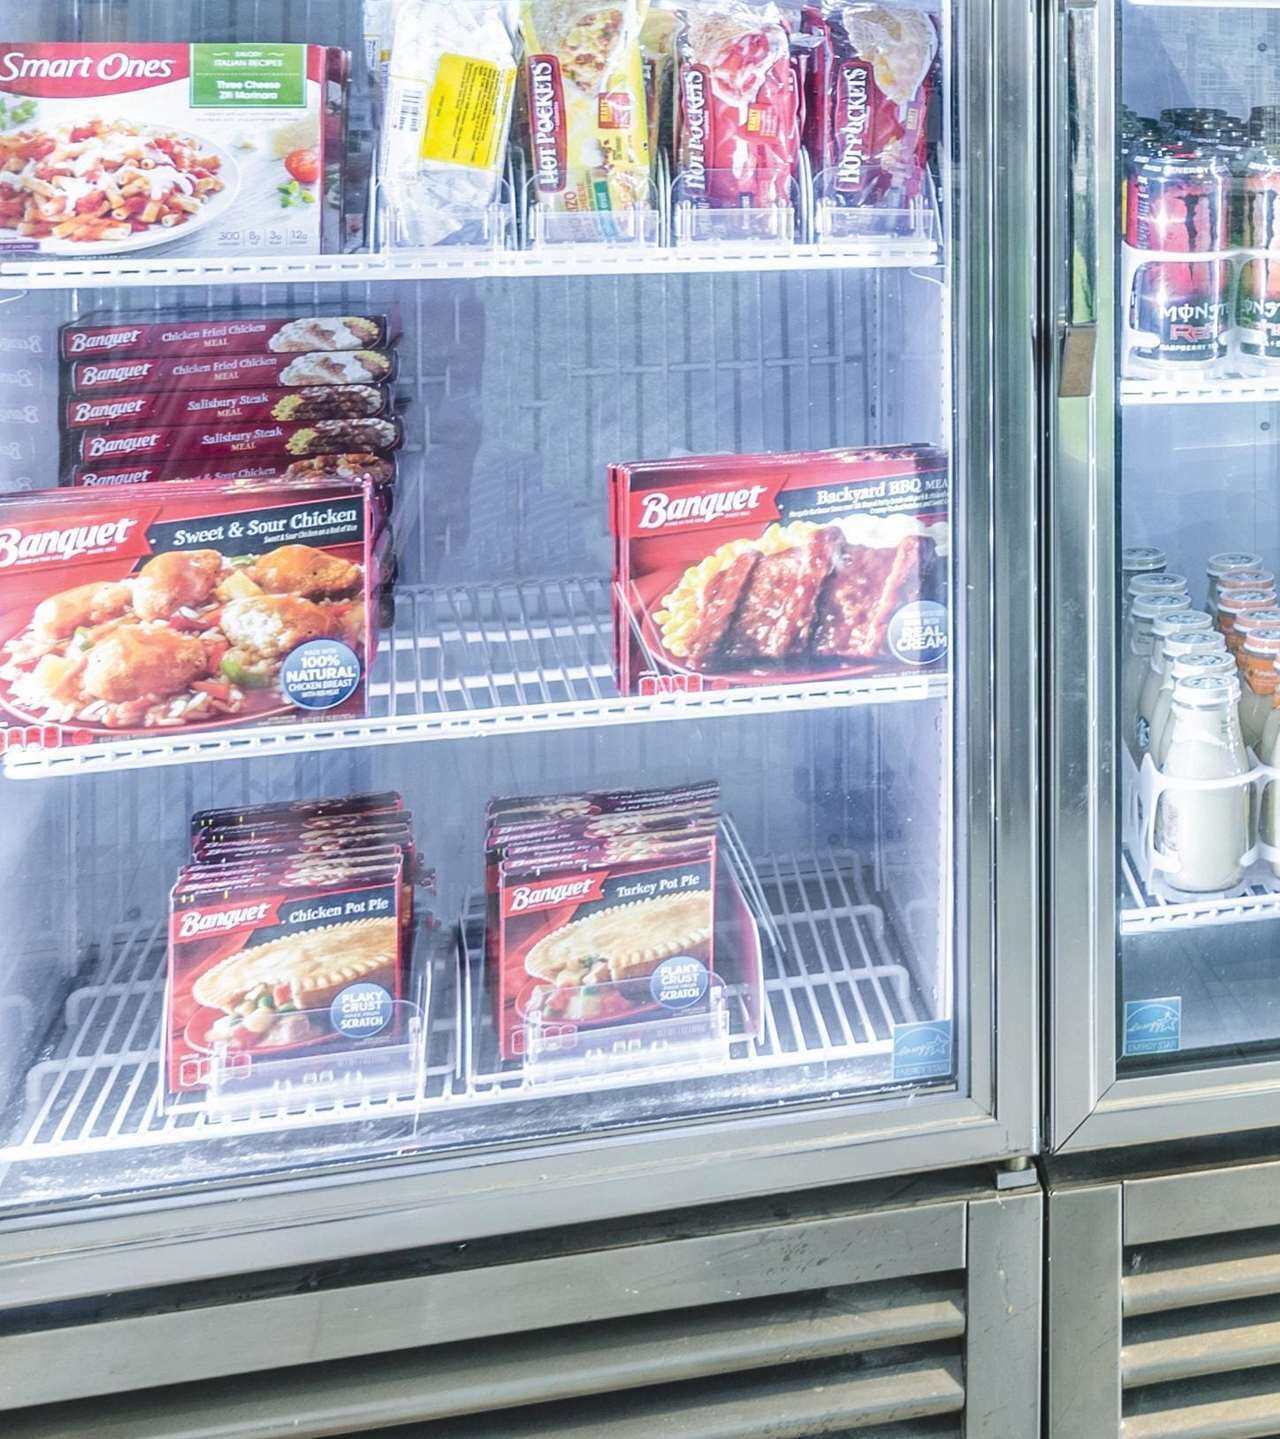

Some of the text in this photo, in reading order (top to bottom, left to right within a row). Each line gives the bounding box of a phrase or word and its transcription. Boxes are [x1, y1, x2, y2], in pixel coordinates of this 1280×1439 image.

[0, 52, 176, 81] Smart Ones
[216, 80, 281, 90] Three Cheese
[528, 61, 556, 149] POCKETS
[71, 328, 142, 353] Banquet
[161, 323, 266, 342] Chicken Fried Chicken
[203, 338, 228, 347] MEAL
[81, 362, 153, 386] Banquet
[173, 356, 277, 375] Chicken Fried Chicken
[214, 371, 240, 380] MEAL
[75, 399, 147, 423] Banquet
[187, 393, 269, 412] Salisbury Steak
[217, 408, 242, 417] MEAL
[89, 431, 161, 456] Banquet
[201, 427, 282, 445] Salisbury Steak
[231, 441, 256, 451] MEAL
[816, 483, 885, 507] Backyard
[888, 478, 921, 497] BBQ
[638, 484, 768, 529] Banquet
[173, 526, 224, 546] Sweet
[228, 522, 245, 538] &
[247, 519, 287, 535] Sour
[291, 508, 357, 530] Chicken
[0, 518, 138, 566] Banquet
[300, 655, 341, 668] 100%
[285, 666, 356, 682] NATURAL
[511, 879, 594, 910] Banquet
[616, 874, 700, 898] Turkey Pot Pie
[180, 902, 272, 938] Banquet
[289, 898, 389, 924] Chicken Pot Pie
